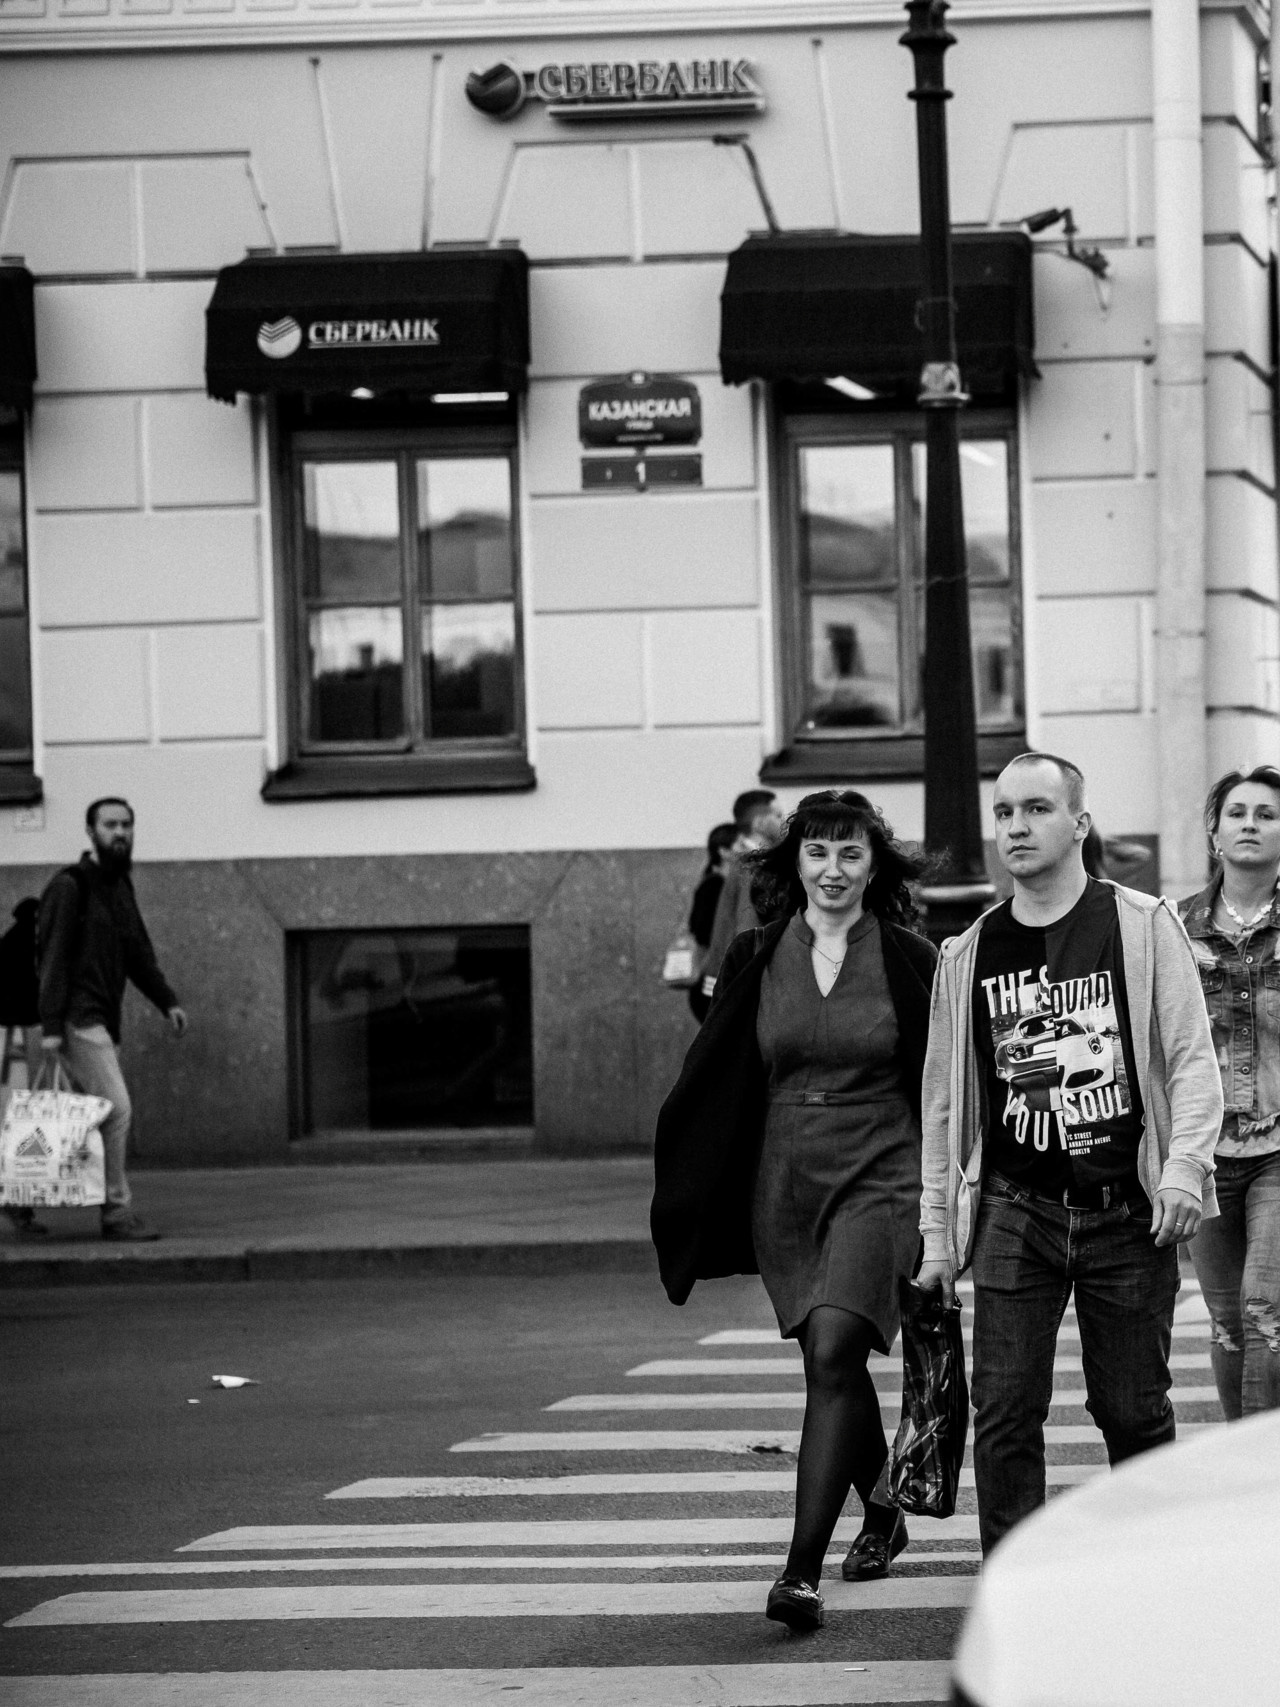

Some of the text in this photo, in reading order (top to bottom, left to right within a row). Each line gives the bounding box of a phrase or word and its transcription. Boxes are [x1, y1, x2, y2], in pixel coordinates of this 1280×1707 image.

[534, 59, 762, 99] СБЕРБАНК
[308, 318, 439, 344] СБЕРБАНК
[588, 397, 692, 420] КАЗАНСКАЯ
[635, 462, 646, 484] 1
[1062, 1084, 1130, 1125] SOUL
[1074, 1131, 1092, 1140] STREET
